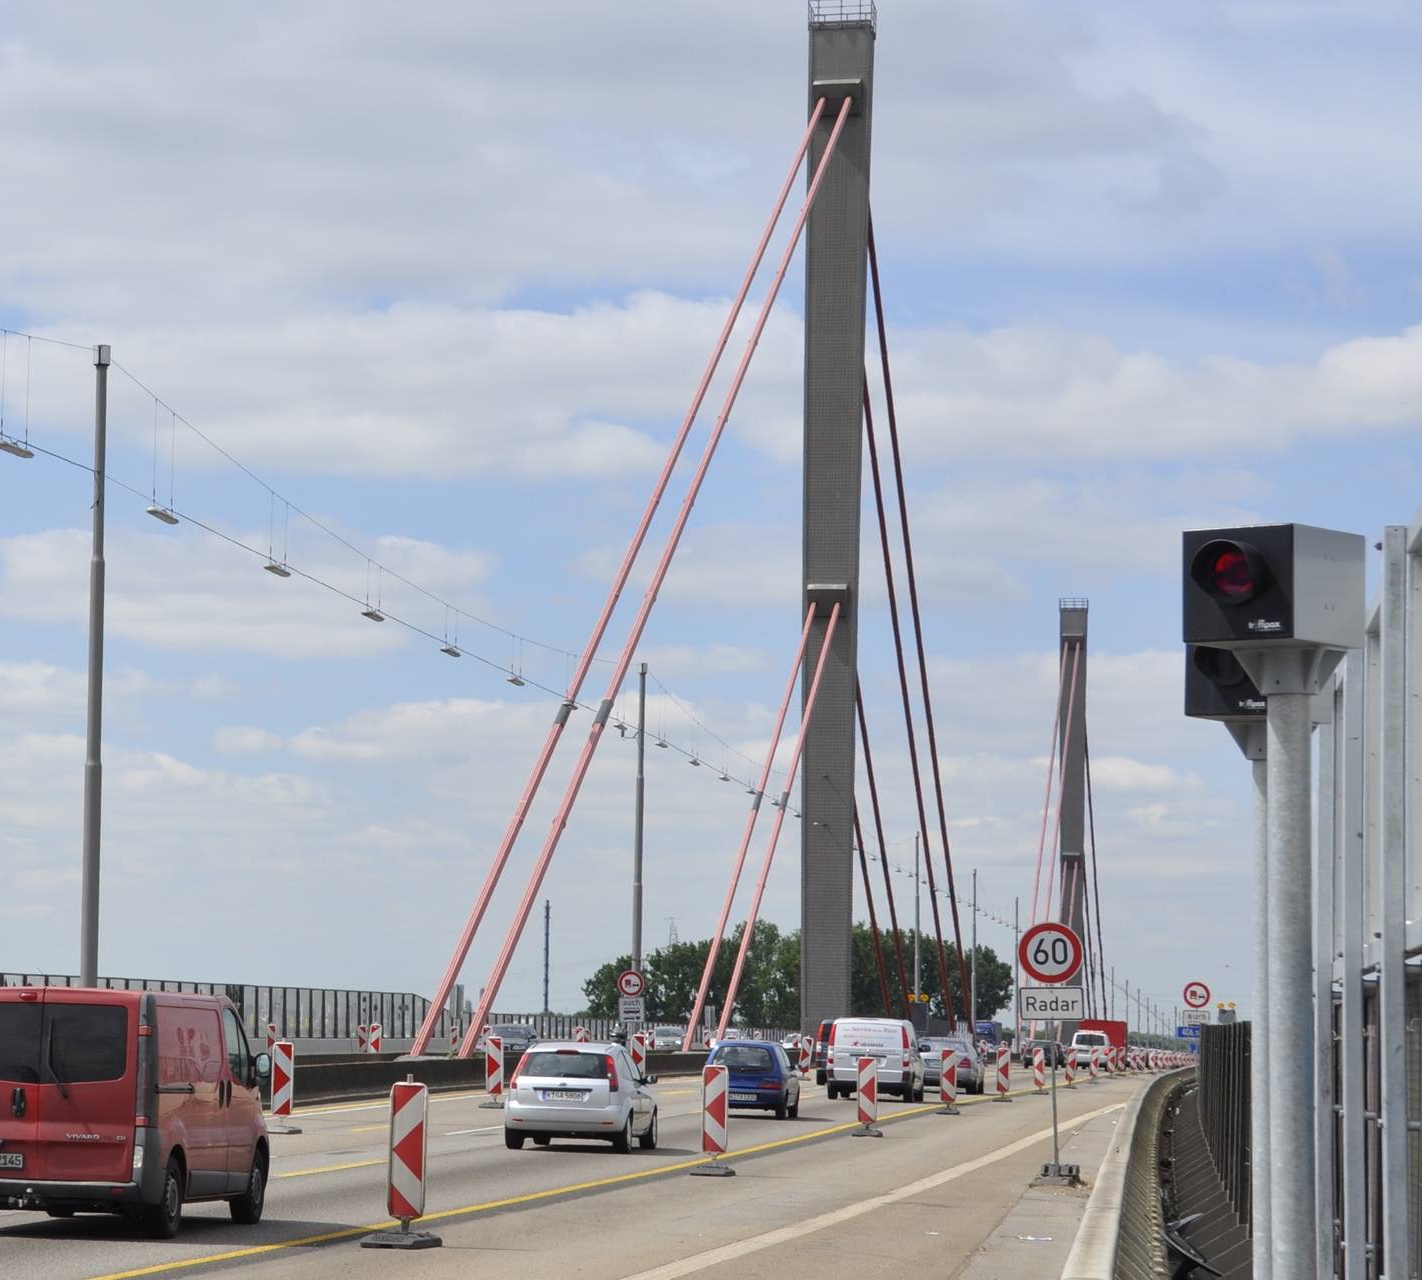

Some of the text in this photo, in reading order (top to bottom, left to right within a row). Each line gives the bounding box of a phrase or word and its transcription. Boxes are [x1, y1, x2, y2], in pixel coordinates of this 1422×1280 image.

[1033, 937, 1068, 965] 60
[1025, 996, 1079, 1012] Radar
[66, 1132, 100, 1140] VIVARO
